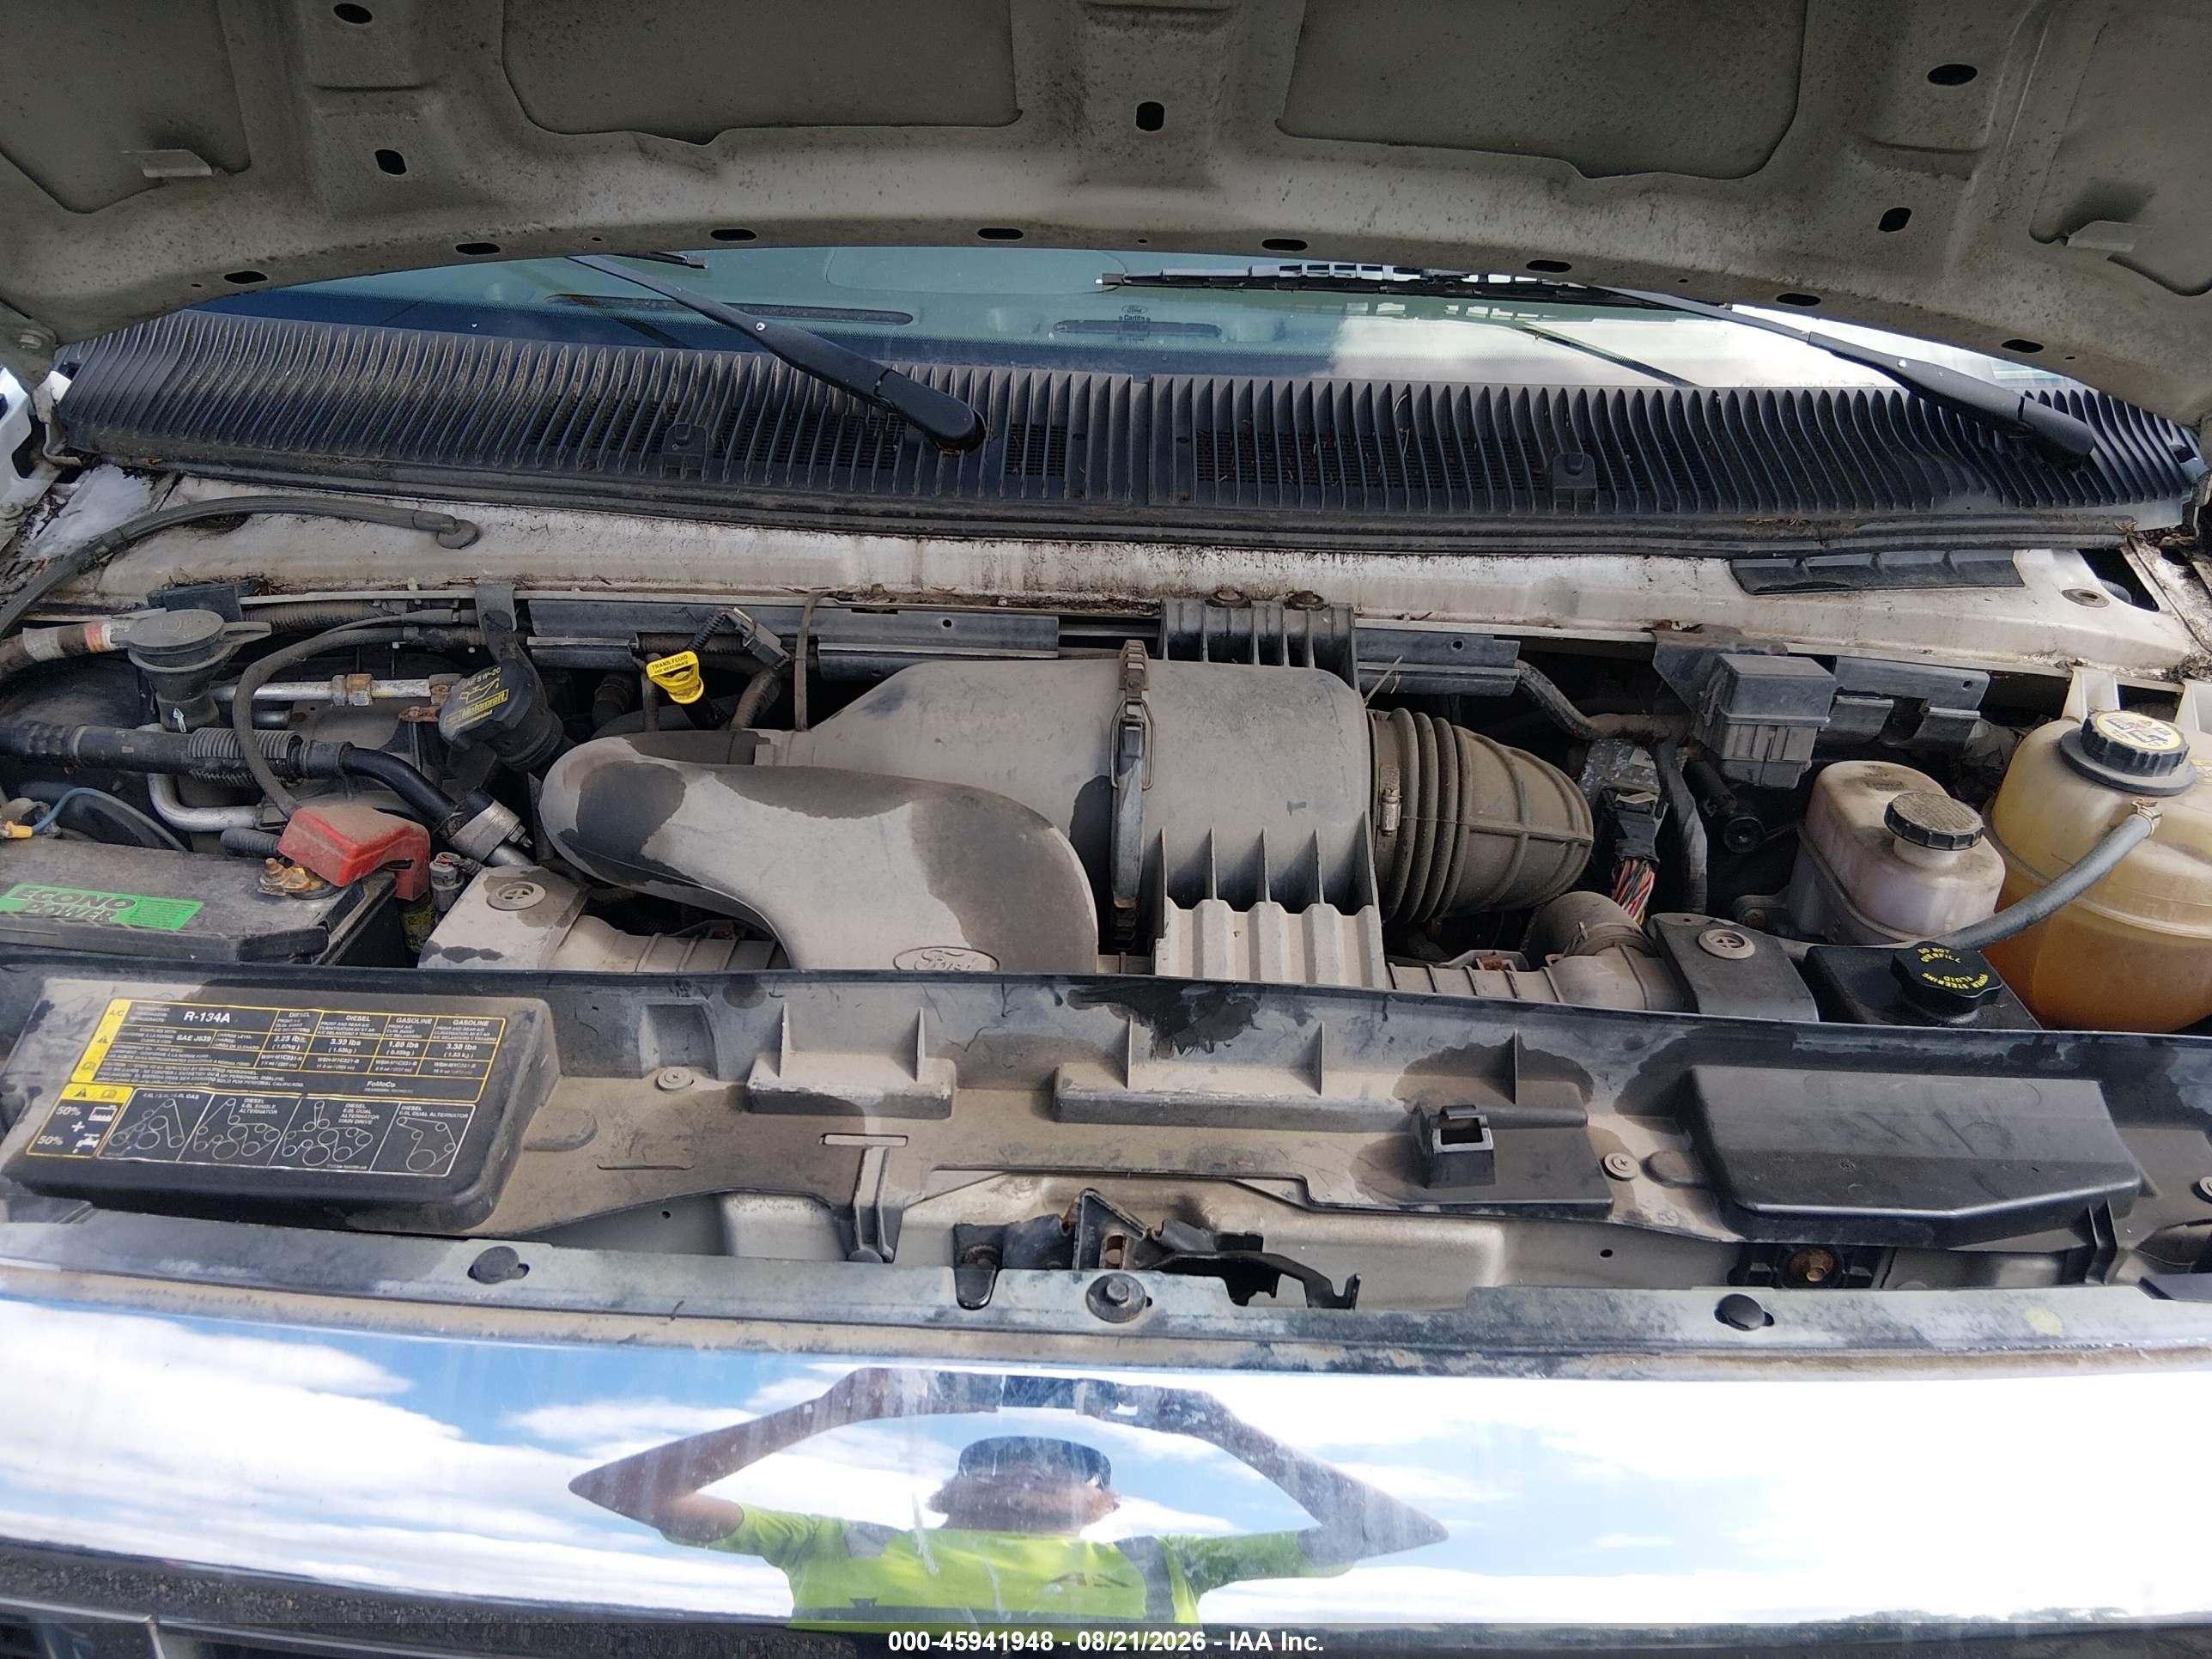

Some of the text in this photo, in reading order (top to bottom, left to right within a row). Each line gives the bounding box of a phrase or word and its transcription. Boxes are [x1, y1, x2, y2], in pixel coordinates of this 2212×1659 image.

[12, 887, 137, 911] ECONO
[184, 1012, 230, 1024] R-134A
[56, 1106, 82, 1116] 50%
[37, 1135, 64, 1146] 50%
